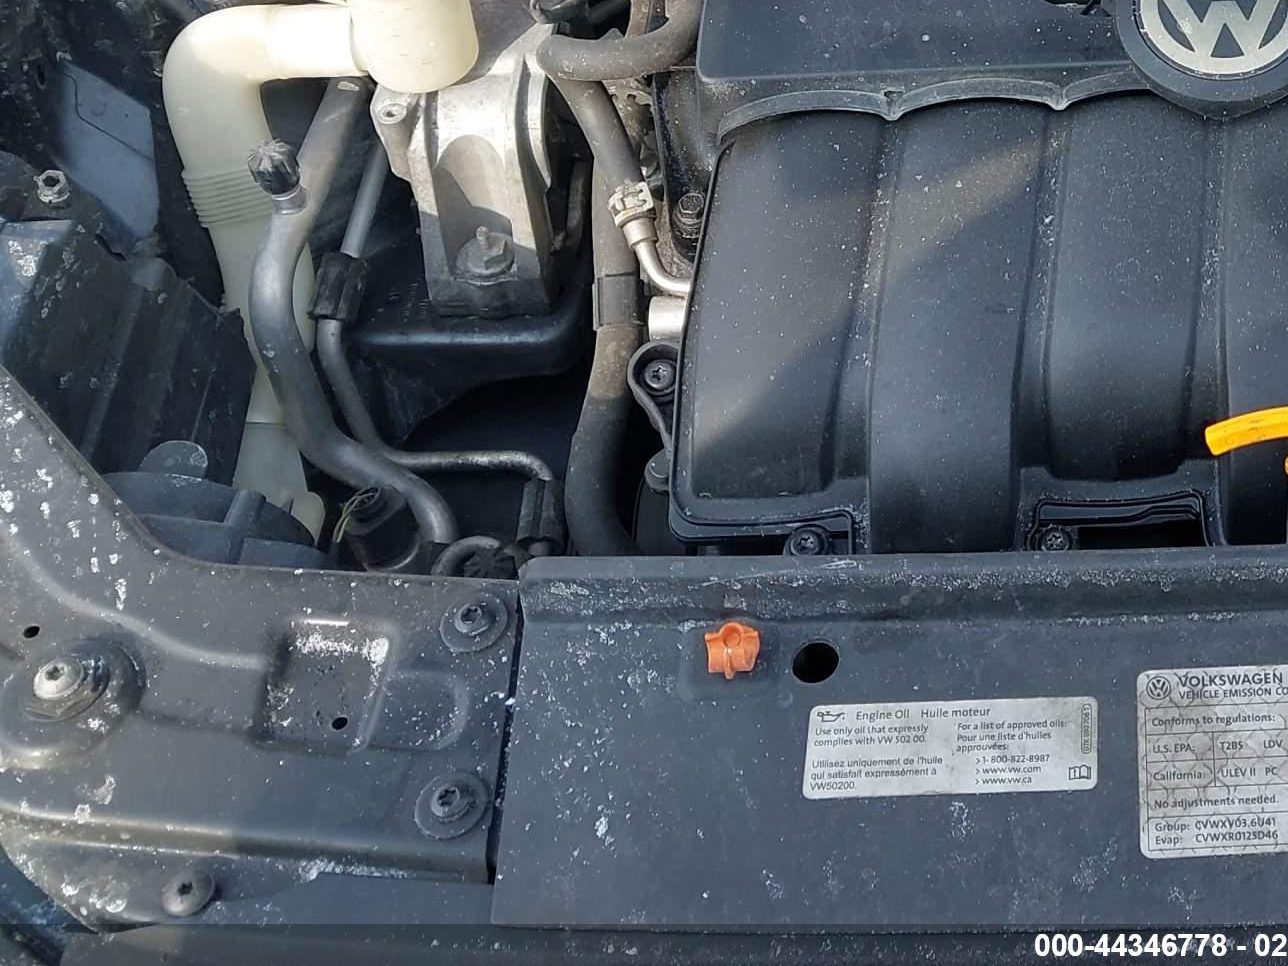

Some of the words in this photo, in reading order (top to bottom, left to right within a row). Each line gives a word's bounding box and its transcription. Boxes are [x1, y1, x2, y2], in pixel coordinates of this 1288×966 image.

[1177, 672, 1282, 687] VOLKSWAGEN
[1178, 689, 1218, 699] VEHICLE
[1223, 687, 1271, 697] EMISSION
[856, 710, 892, 722] Engine
[894, 708, 909, 719] Oil
[920, 708, 948, 718] Huile
[951, 708, 990, 716] moteur
[1151, 715, 1199, 726] Conforms
[1202, 715, 1213, 724] to
[1215, 713, 1274, 726] regulations:
[815, 727, 831, 735] Use
[833, 726, 852, 736] only
[854, 725, 865, 734] oil
[867, 725, 885, 733] that
[887, 723, 928, 734] expressly
[957, 722, 971, 730] For
[980, 721, 993, 729] list
[995, 720, 1005, 729] of
[1007, 719, 1047, 730] approved
[1049, 718, 1066, 727] oils:
[813, 737, 852, 747] complies
[855, 736, 875, 744] with
[877, 736, 893, 744] VW
[895, 735, 910, 743] 502
[956, 733, 976, 741] Pour
[997, 732, 1015, 740] liste
[1017, 730, 1051, 739] d'huiles
[956, 741, 1008, 753] approuvées:
[1152, 744, 1171, 753] U.S.
[1174, 743, 1195, 752] EPA:
[1219, 740, 1243, 750] T2B5
[1263, 738, 1283, 748] LDV
[812, 759, 844, 768] Utilisez
[847, 757, 900, 768] uniquement
[902, 757, 914, 765] de
[917, 755, 942, 764] l'huile
[810, 771, 824, 780] qui
[827, 769, 861, 778] satisfait
[864, 767, 928, 777] expressément
[931, 767, 936, 775] à
[1153, 769, 1205, 780] California:
[1220, 767, 1246, 777] ULEV
[1249, 766, 1255, 776] II
[1264, 765, 1277, 775] PC
[981, 776, 1031, 784] www.vw.ca
[1154, 799, 1168, 808] No
[1171, 796, 1234, 810] adjustments
[1237, 793, 1278, 804] needed.
[1154, 821, 1189, 831] Group:
[1155, 835, 1182, 846] Evap:
